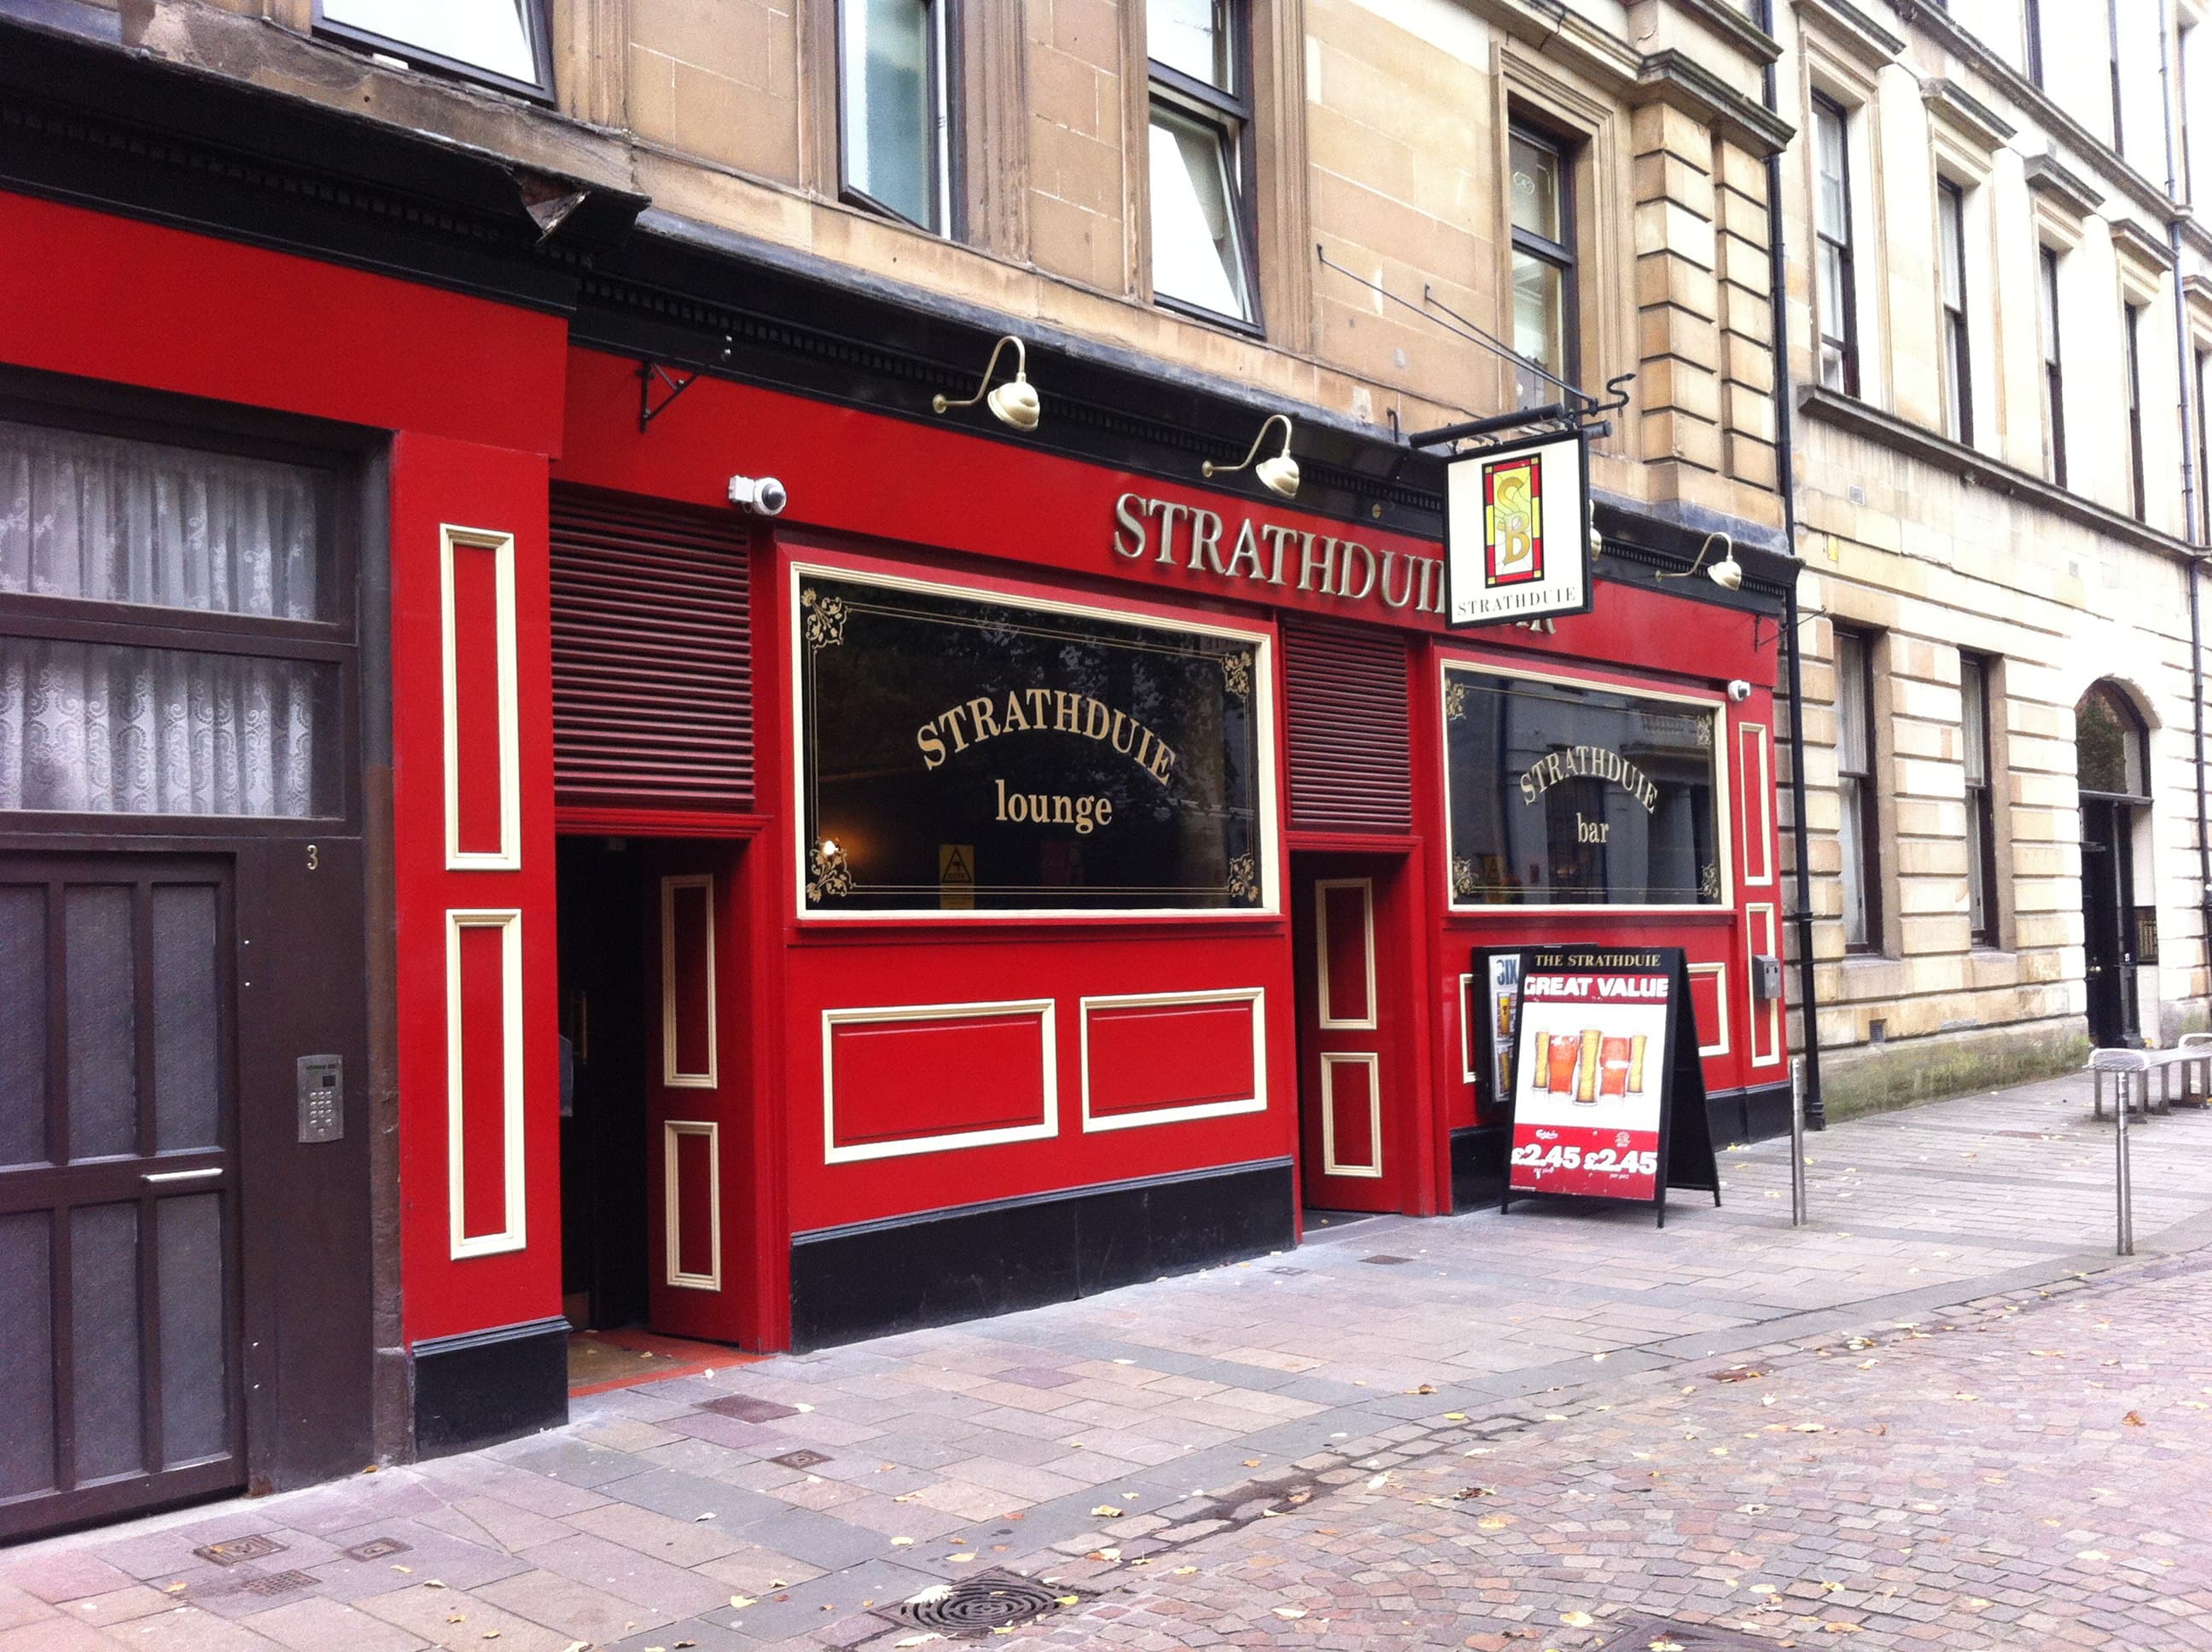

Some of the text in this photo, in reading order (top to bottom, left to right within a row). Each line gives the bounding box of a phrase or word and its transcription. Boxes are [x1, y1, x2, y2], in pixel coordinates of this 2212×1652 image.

[1458, 586, 1576, 617] STRATHDUIE
[917, 688, 1176, 786] STRATHDUIE
[1520, 745, 1659, 814] STRATHDUIE
[995, 779, 1113, 834] lounge
[1576, 811, 1610, 844] bar
[306, 844, 319, 870] 3
[1535, 954, 1662, 968] THE STRATHDUIE
[1524, 976, 1668, 998] GREAT VALUE
[1511, 1143, 1581, 1170] £2.45
[1583, 1148, 1658, 1175] £2.45
